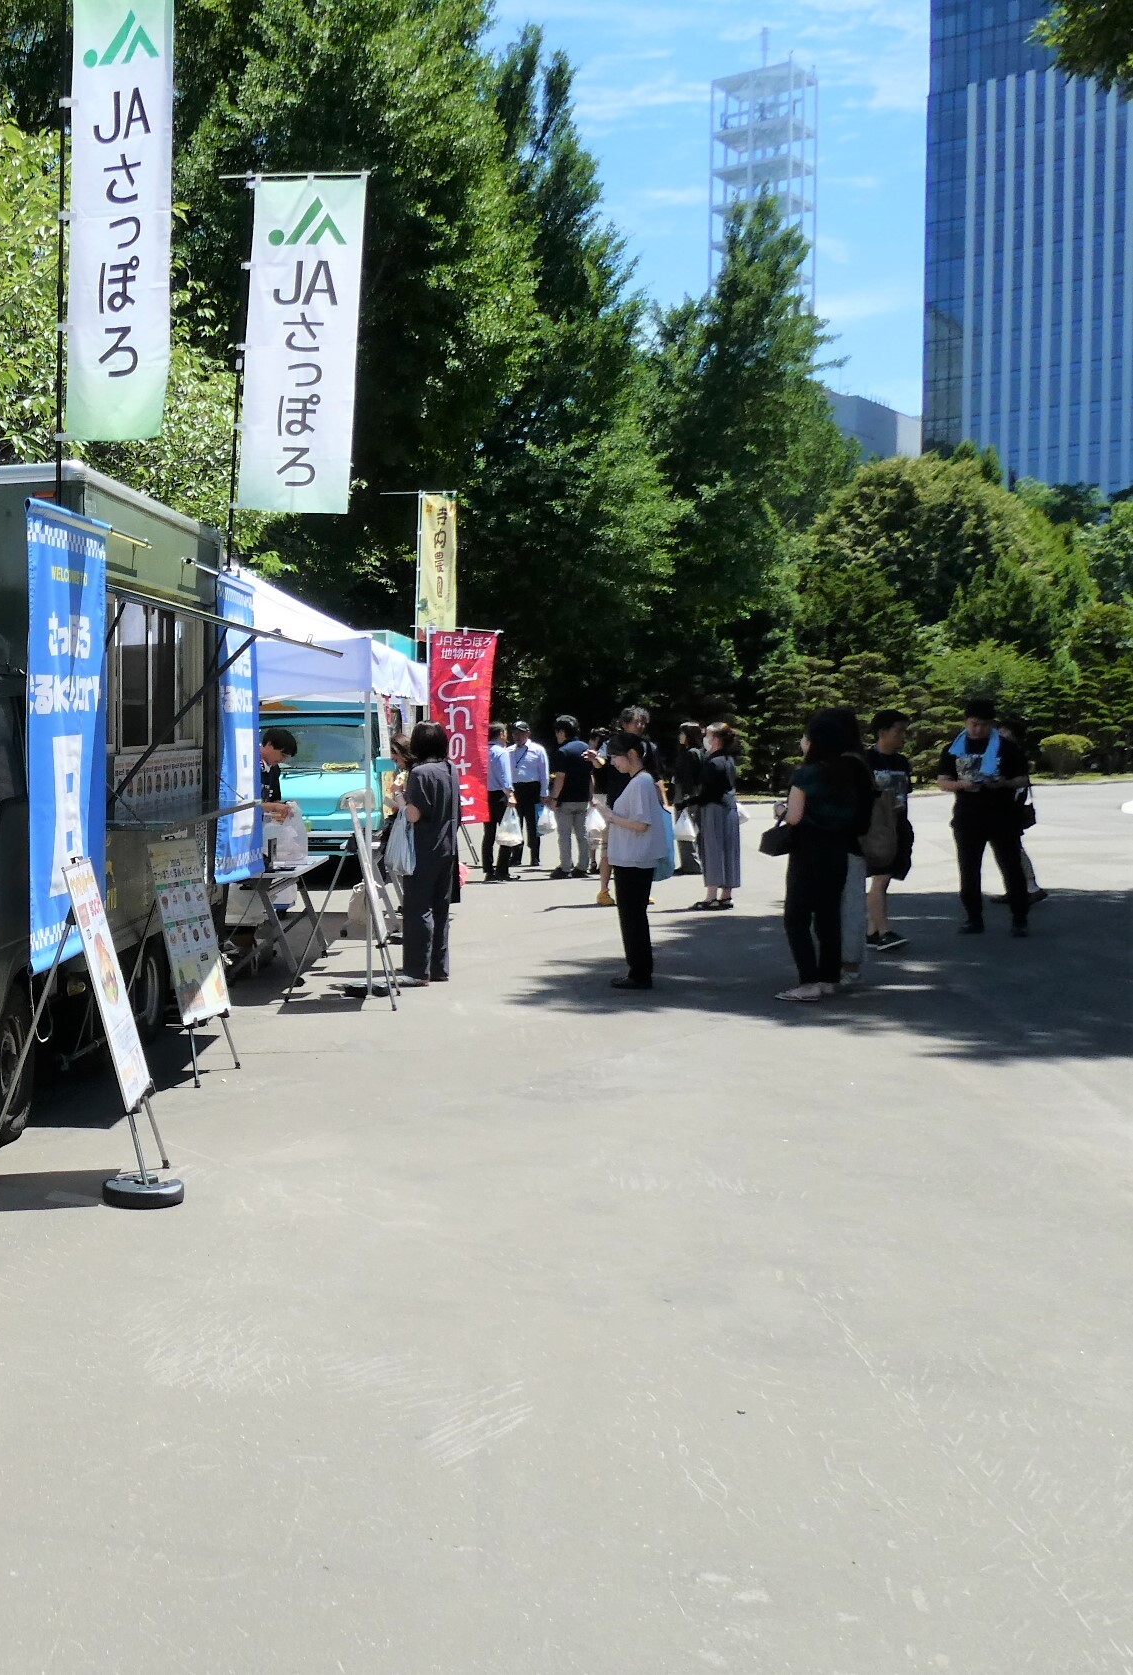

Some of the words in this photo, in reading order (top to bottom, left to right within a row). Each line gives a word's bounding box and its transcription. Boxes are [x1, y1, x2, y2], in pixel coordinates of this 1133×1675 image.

[93, 86, 151, 378] JAさっぽろ
[272, 260, 338, 487] JAさっぽろ
